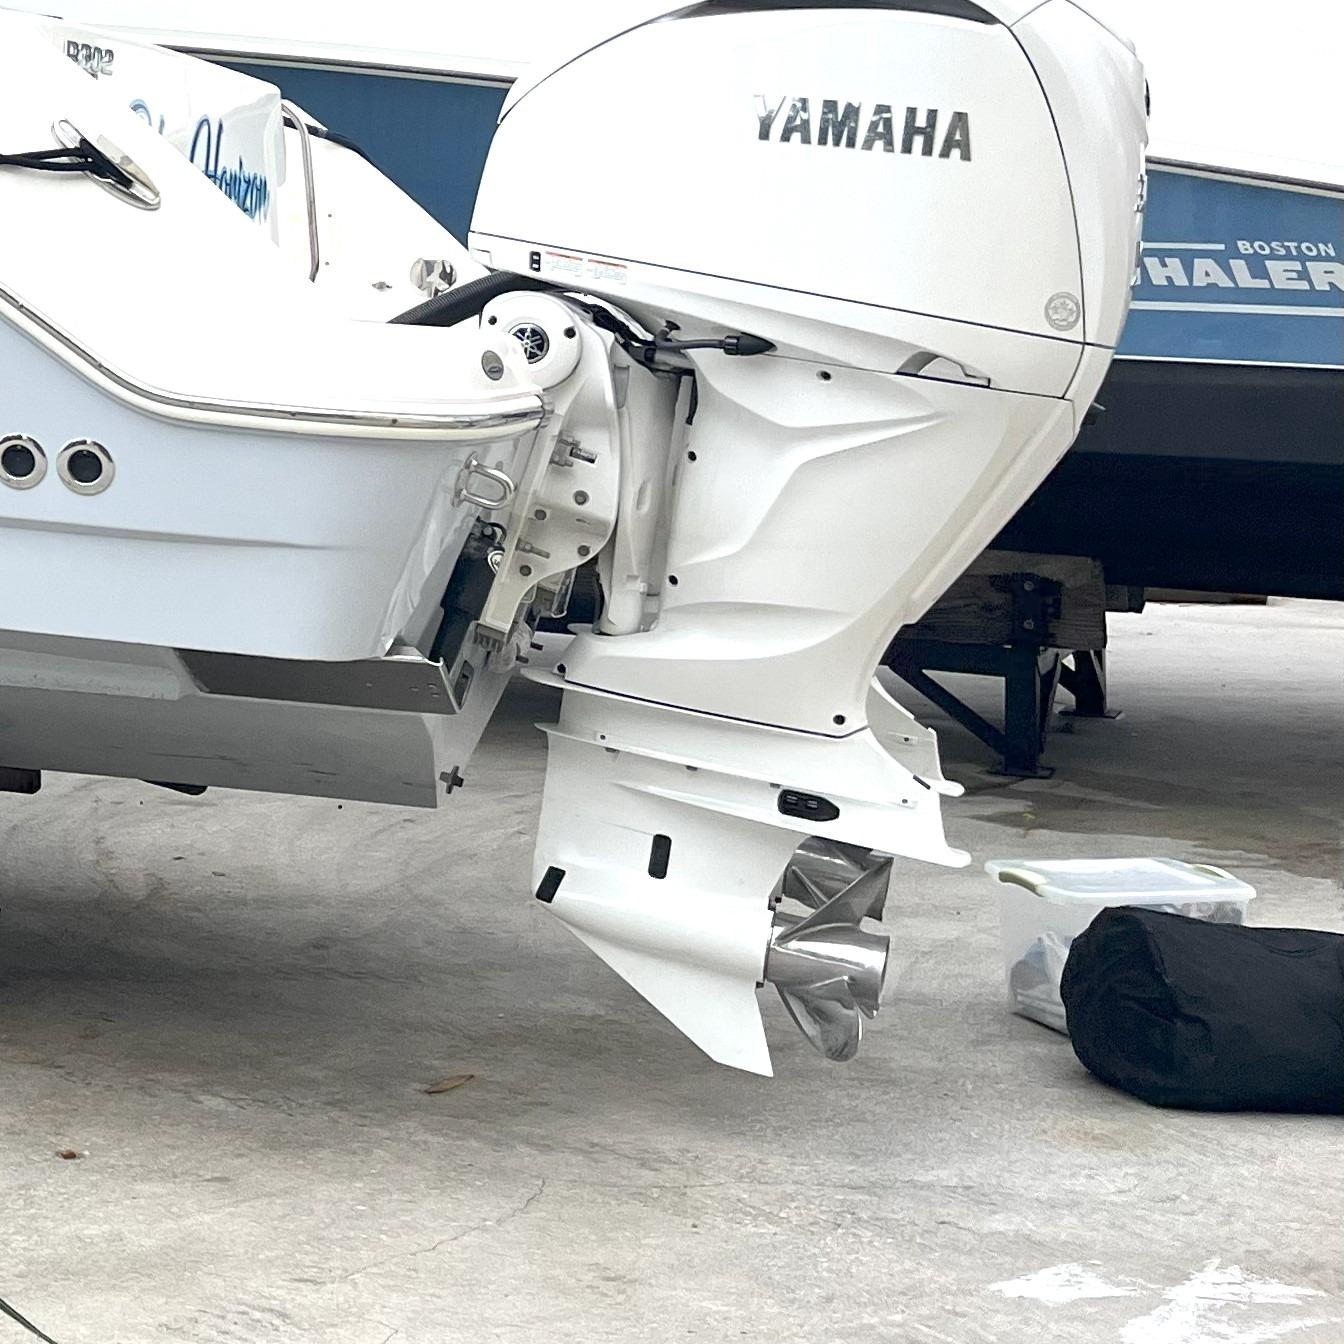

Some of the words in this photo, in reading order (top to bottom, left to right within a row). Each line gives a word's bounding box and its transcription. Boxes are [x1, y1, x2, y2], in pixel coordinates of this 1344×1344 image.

[753, 94, 972, 162] YAMAHA
[1236, 240, 1336, 257] BOSTON
[1136, 257, 1344, 291] HALER
